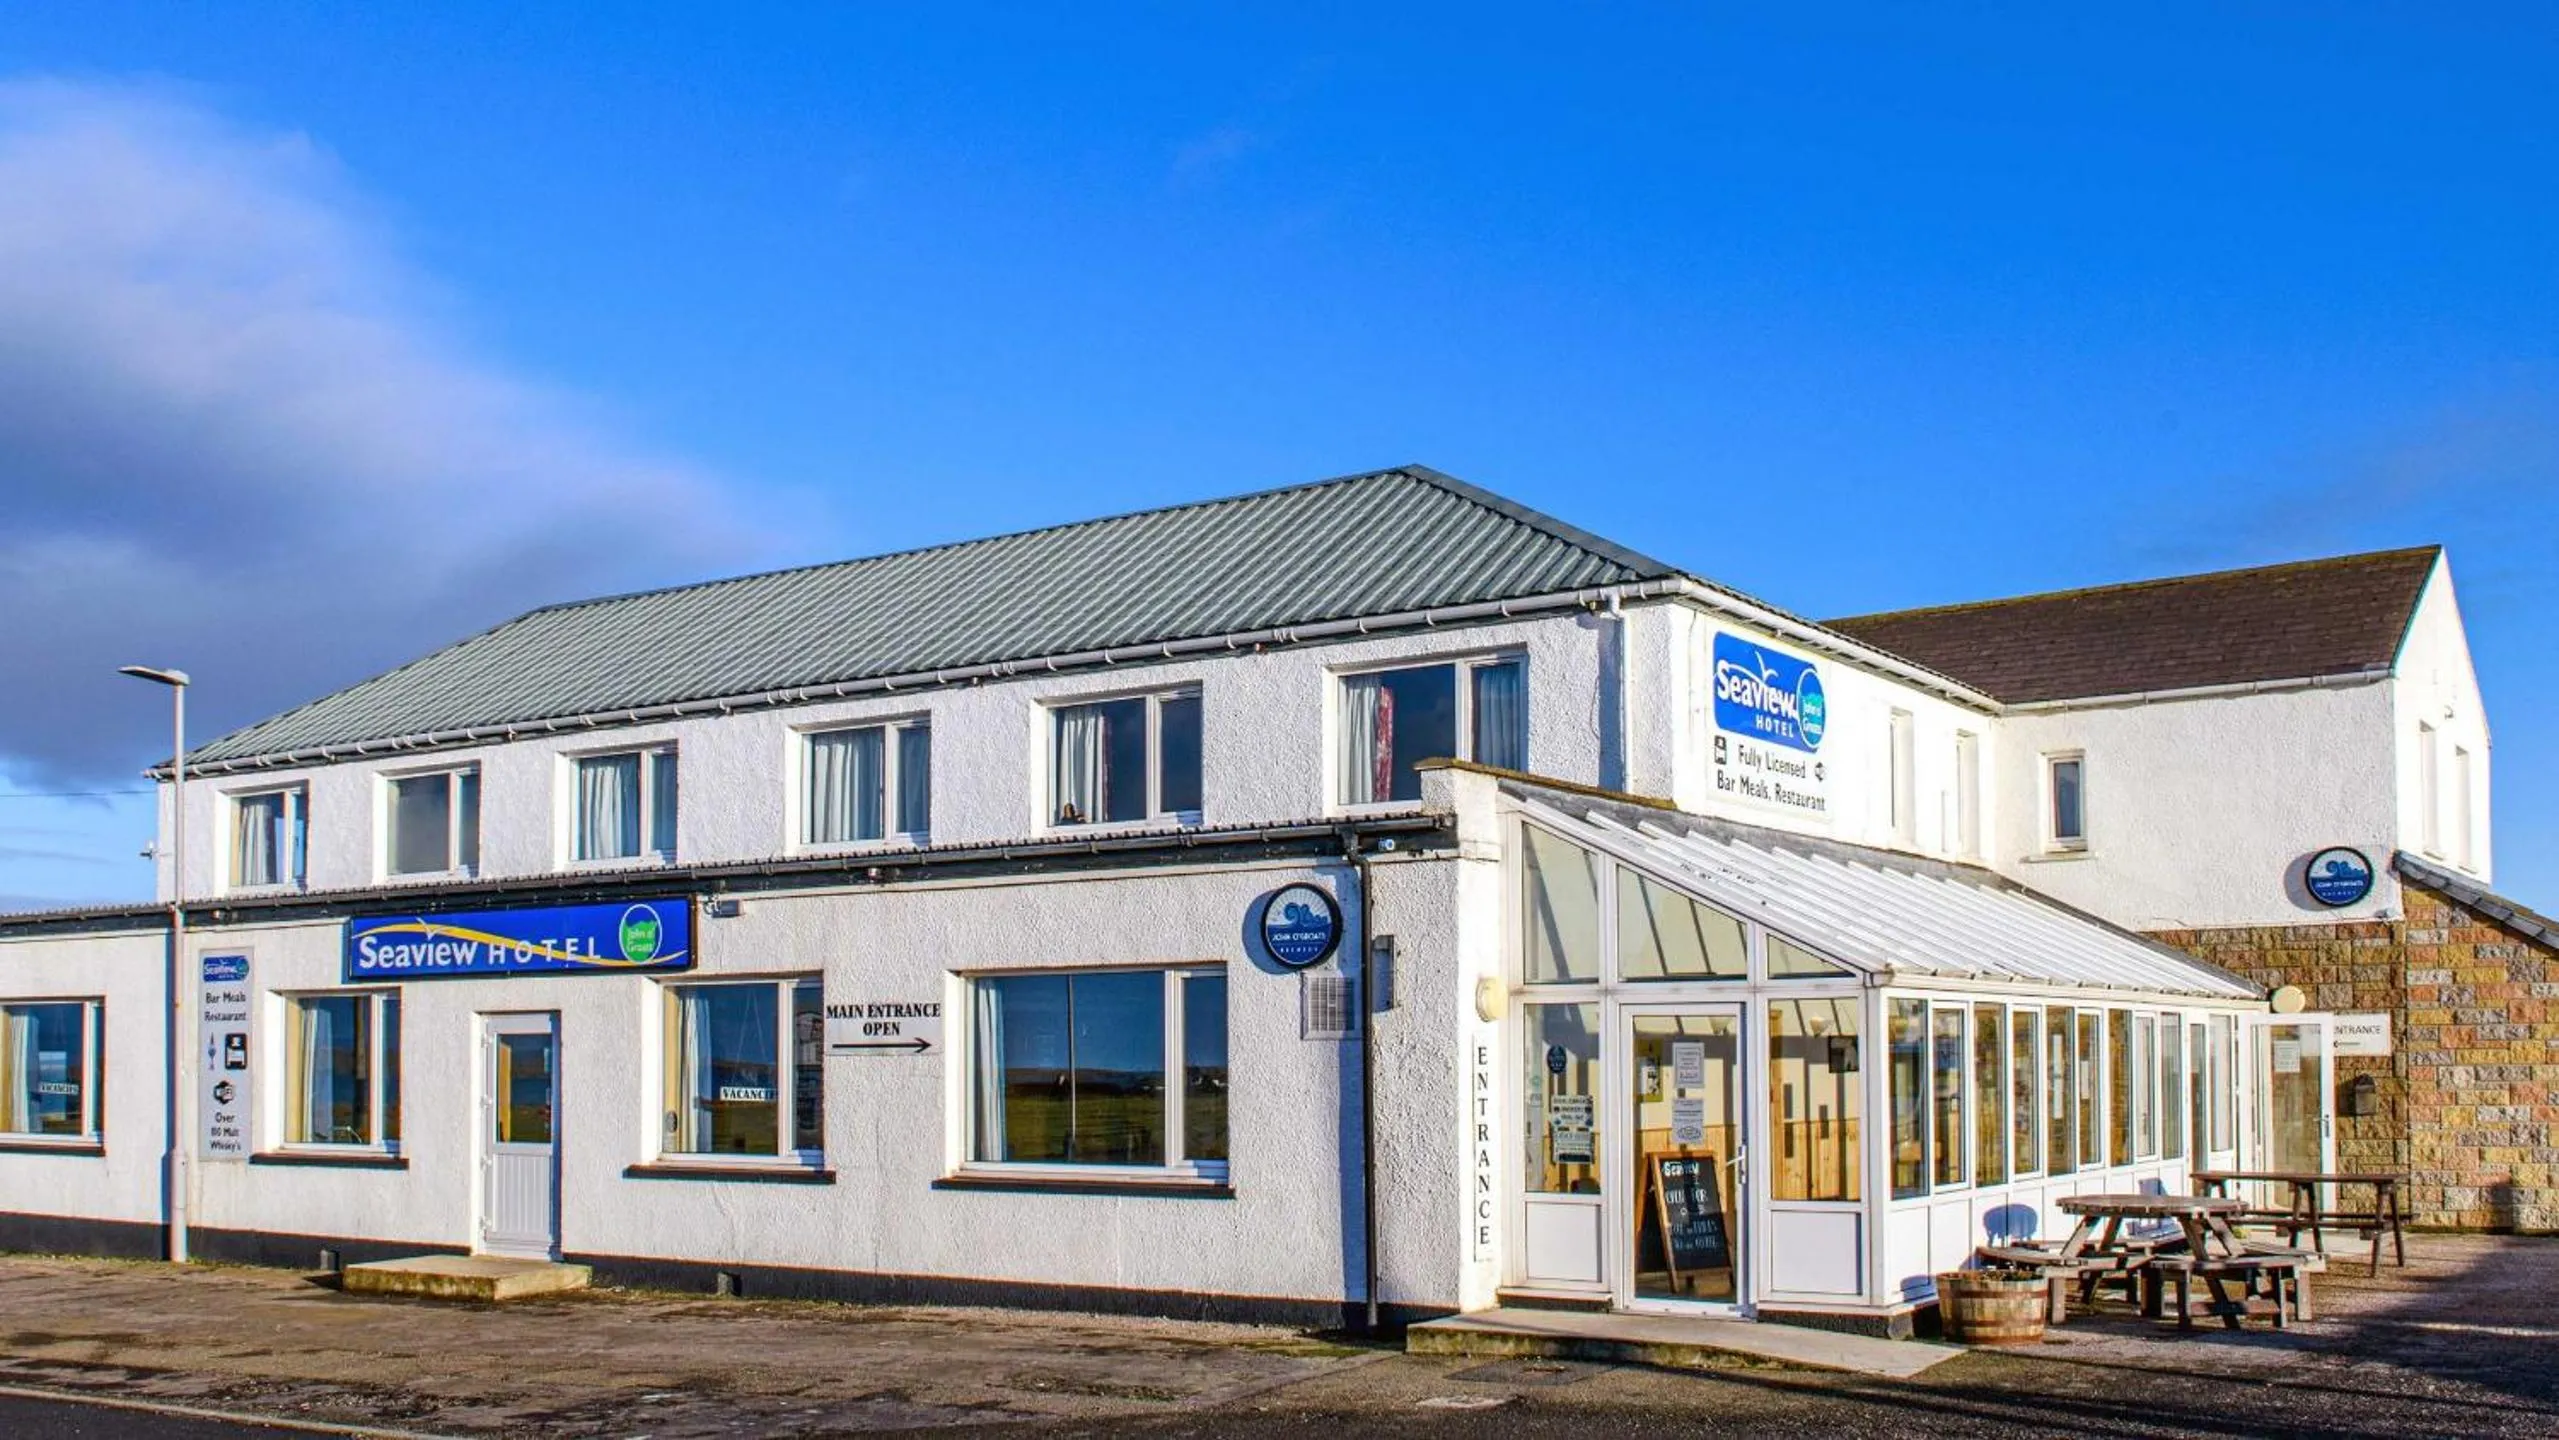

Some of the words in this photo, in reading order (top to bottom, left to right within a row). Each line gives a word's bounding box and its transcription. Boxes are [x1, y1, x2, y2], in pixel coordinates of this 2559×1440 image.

[1717, 659, 1797, 718] Seaview
[1755, 714, 1793, 738] HOTEL
[1738, 744, 1761, 773] Fully
[1765, 751, 1806, 779] Licensed
[1717, 769, 1736, 792] Bar
[1775, 782, 1825, 811] Restaurant
[1272, 932, 1290, 941] JOHN
[359, 936, 478, 969] Seaview
[488, 936, 602, 965] HOTEL
[205, 991, 220, 1004] Bar
[223, 991, 246, 1003] Meals
[204, 1011, 246, 1021] Restaurant
[826, 1004, 864, 1019] MAIN
[867, 1003, 941, 1018] ENTRANCE
[862, 1022, 901, 1036] OPEN
[2334, 1024, 2381, 1035] NTRANCE
[214, 1111, 236, 1123] Over
[1477, 1046, 1490, 1245] ENTRANCE
